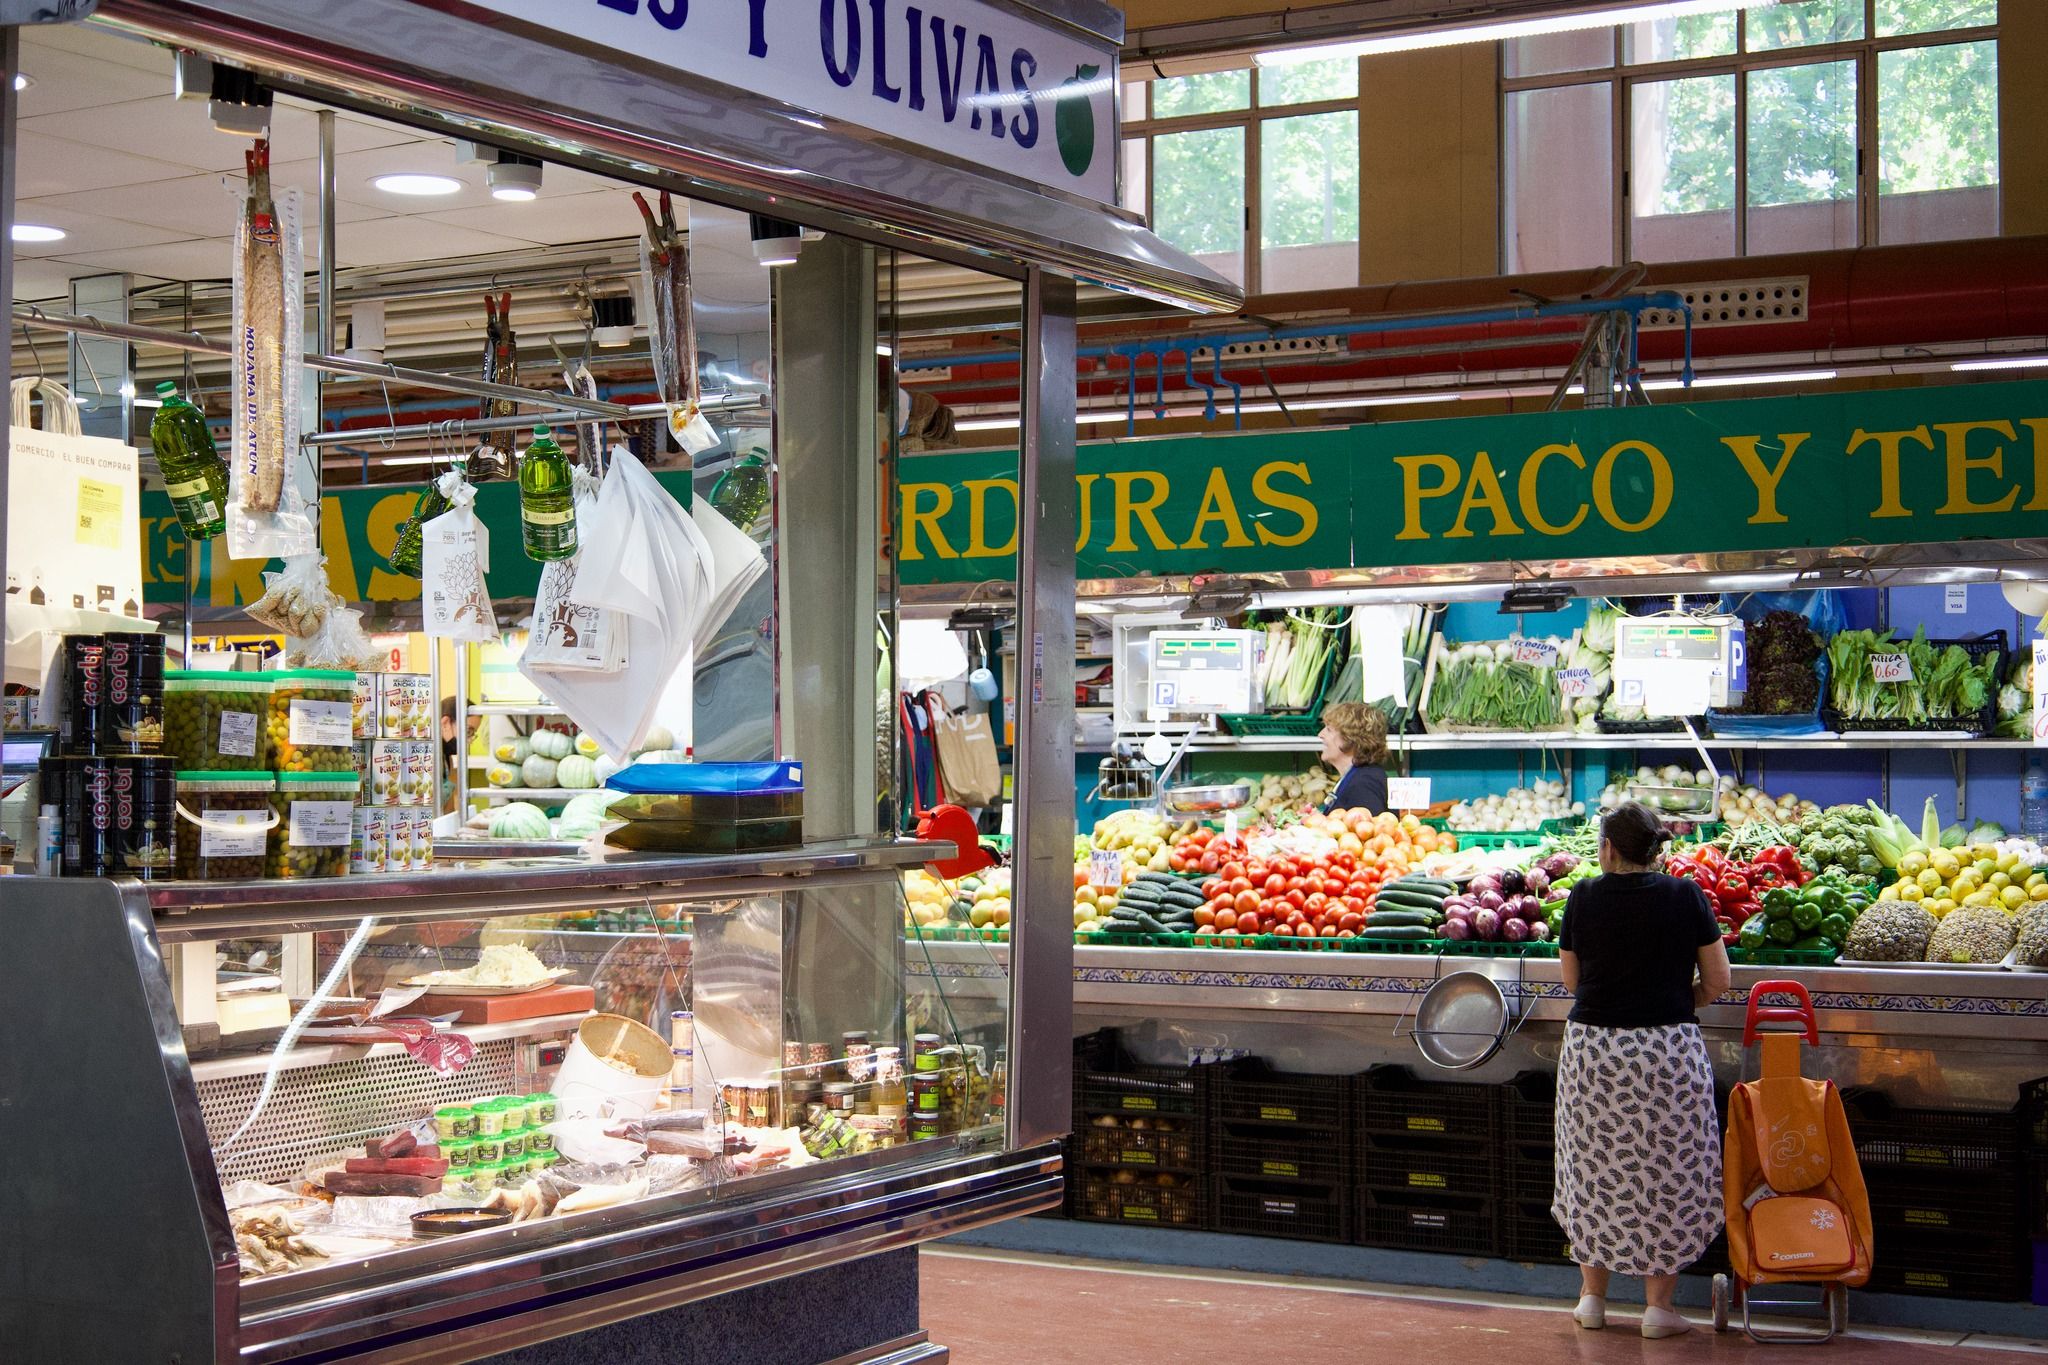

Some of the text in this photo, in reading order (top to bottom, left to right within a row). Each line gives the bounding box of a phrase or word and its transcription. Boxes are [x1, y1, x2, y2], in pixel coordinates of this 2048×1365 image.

[820, 0, 1039, 149] OLIVAS
[245, 326, 260, 475] MOJAMA DE ATÚN
[15, 443, 131, 472] COMERCIO EL BUEN COMPRAR
[1393, 440, 1674, 540] PACO
[1720, 432, 1811, 524] Y
[76, 642, 103, 706] corbi
[106, 640, 129, 704] corbi
[1731, 640, 1744, 680] P
[1158, 683, 1174, 704] P
[1624, 681, 1641, 704] P
[84, 765, 112, 830] corbi
[113, 766, 133, 830] corbi
[1779, 1251, 1815, 1261] consum
